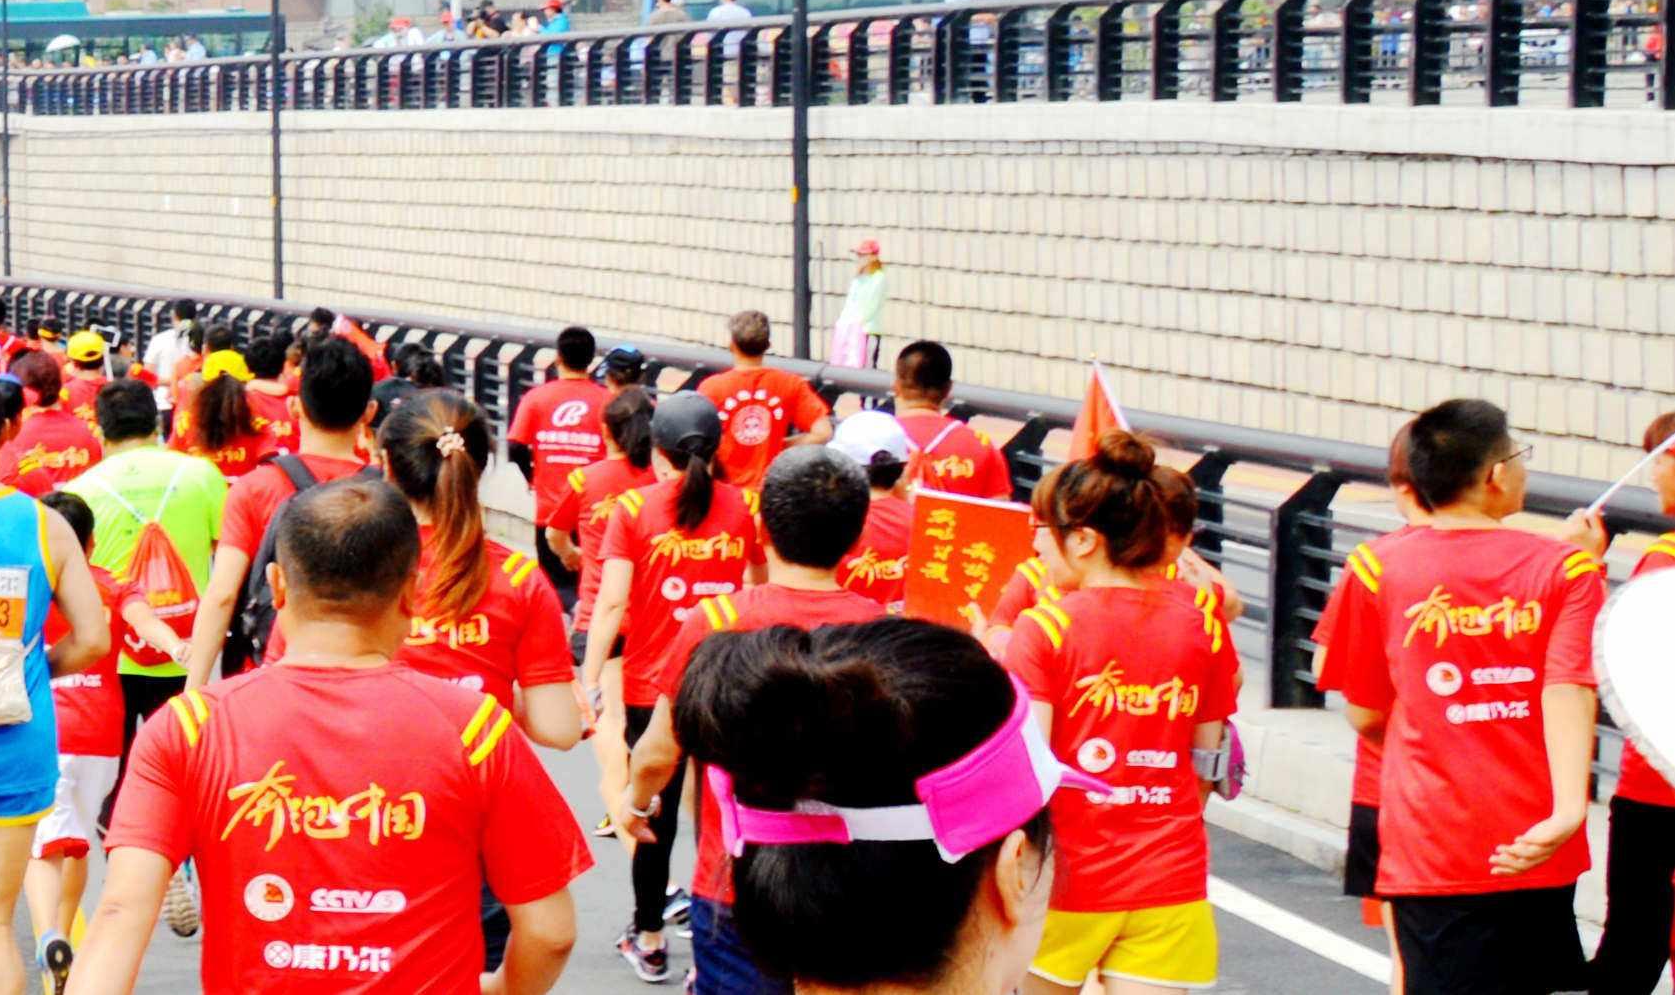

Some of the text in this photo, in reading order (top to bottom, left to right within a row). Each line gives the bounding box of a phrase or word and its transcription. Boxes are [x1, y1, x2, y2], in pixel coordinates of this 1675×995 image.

[220, 760, 427, 853] 奔跑中国
[291, 943, 393, 973] 康乃尔
